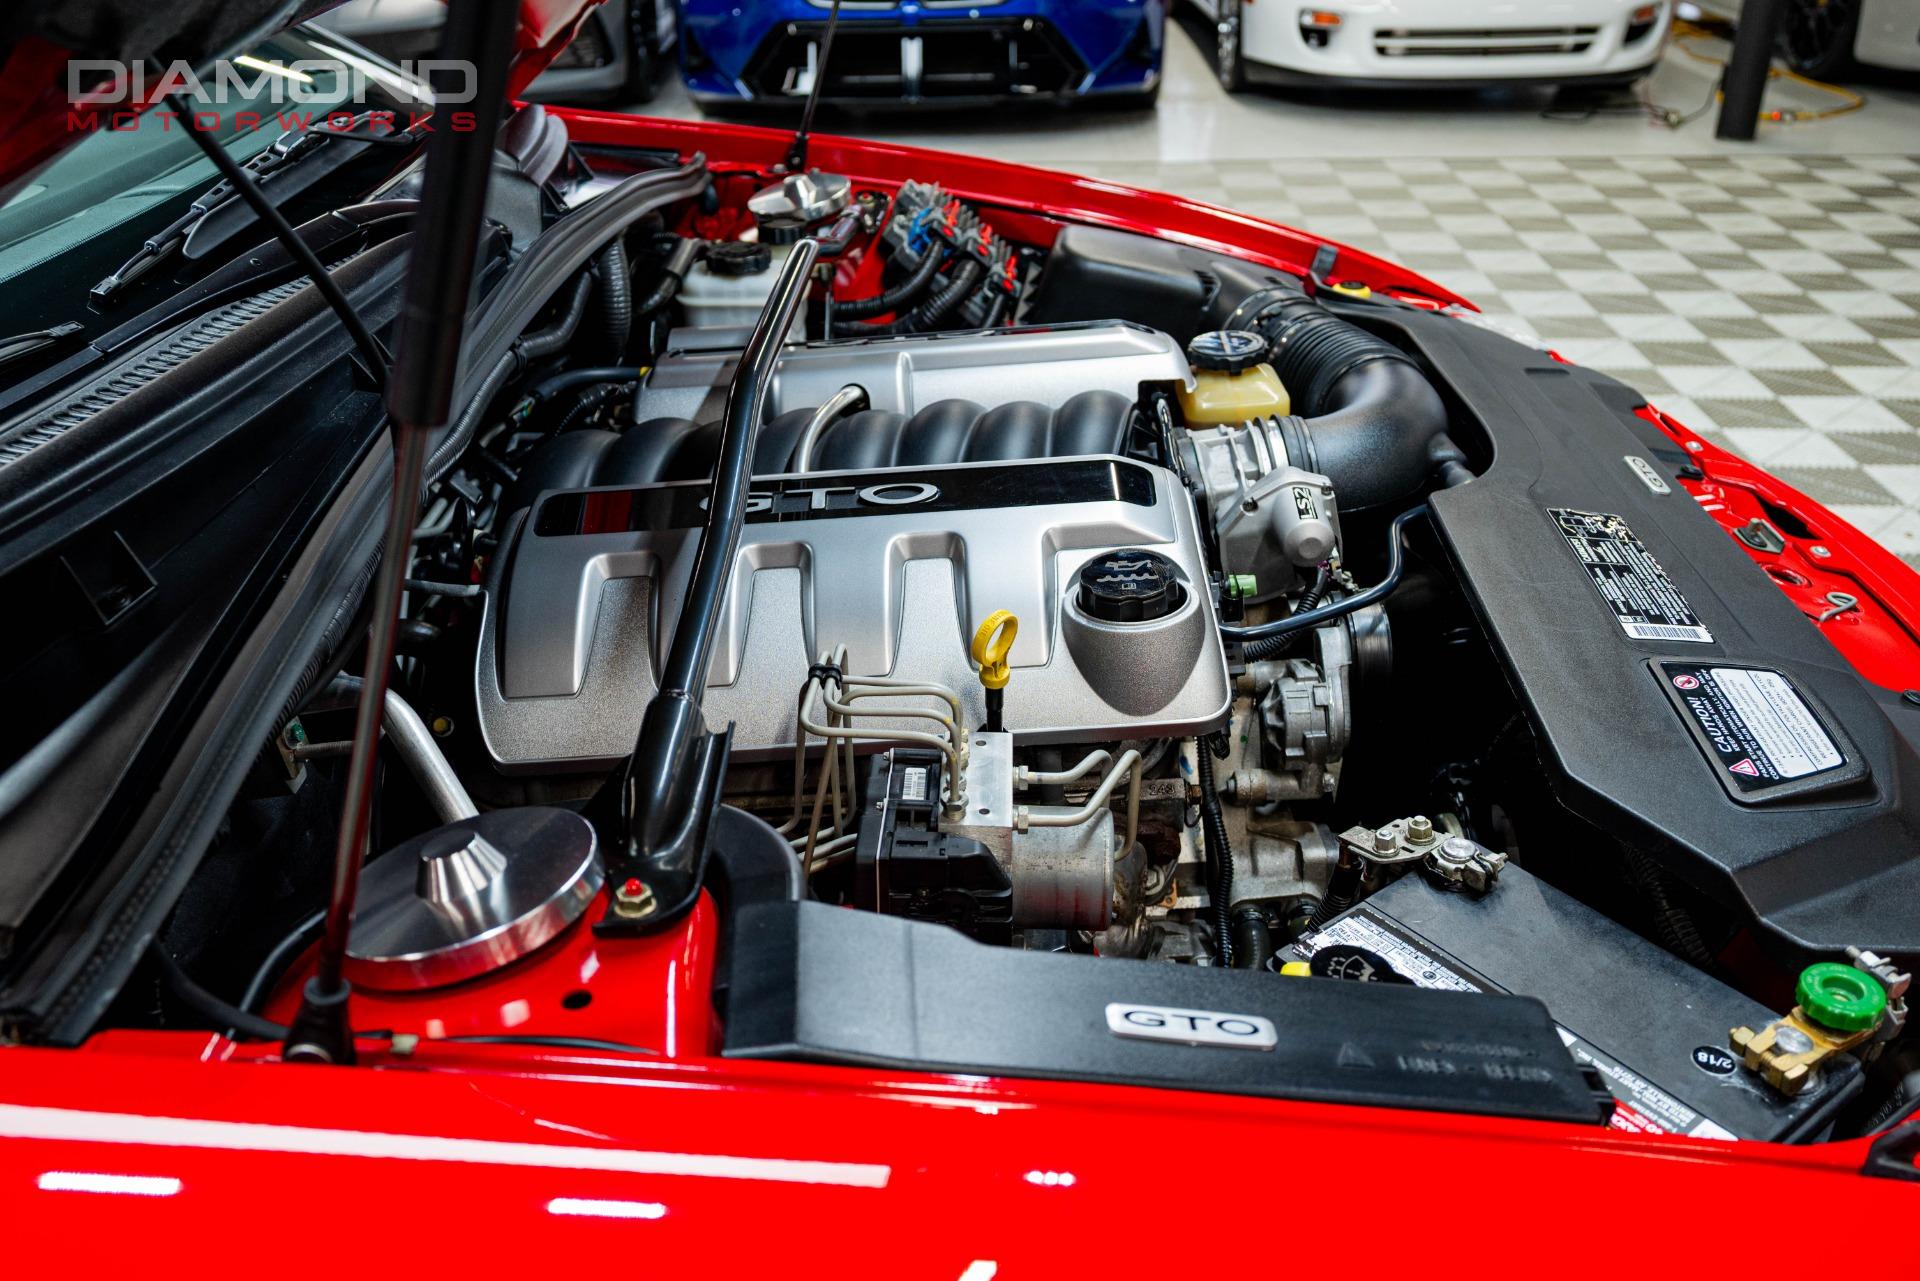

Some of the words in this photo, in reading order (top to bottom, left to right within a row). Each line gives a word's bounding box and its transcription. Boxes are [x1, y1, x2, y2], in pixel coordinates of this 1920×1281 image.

[1294, 488, 1316, 519] LS2
[1694, 671, 1707, 683] MAY
[1699, 668, 1711, 680] OFF
[1702, 684, 1715, 696] AND
[1711, 687, 1732, 709] IGNITION
[1699, 696, 1716, 713] AWAY
[1686, 695, 1733, 753] CAUTION!
[1711, 714, 1730, 735] HANDS
[1728, 710, 1744, 727] WHEN
[1740, 727, 1753, 740] RUN
[1725, 735, 1741, 751] KEEP
[1740, 740, 1758, 760] START
[1749, 740, 1759, 749] TO
[1754, 760, 1770, 778] FANS
[1755, 749, 1780, 780] CONTINUE
[1124, 1010, 1261, 1037] GTO
[1697, 1051, 1733, 1069] 2/18
